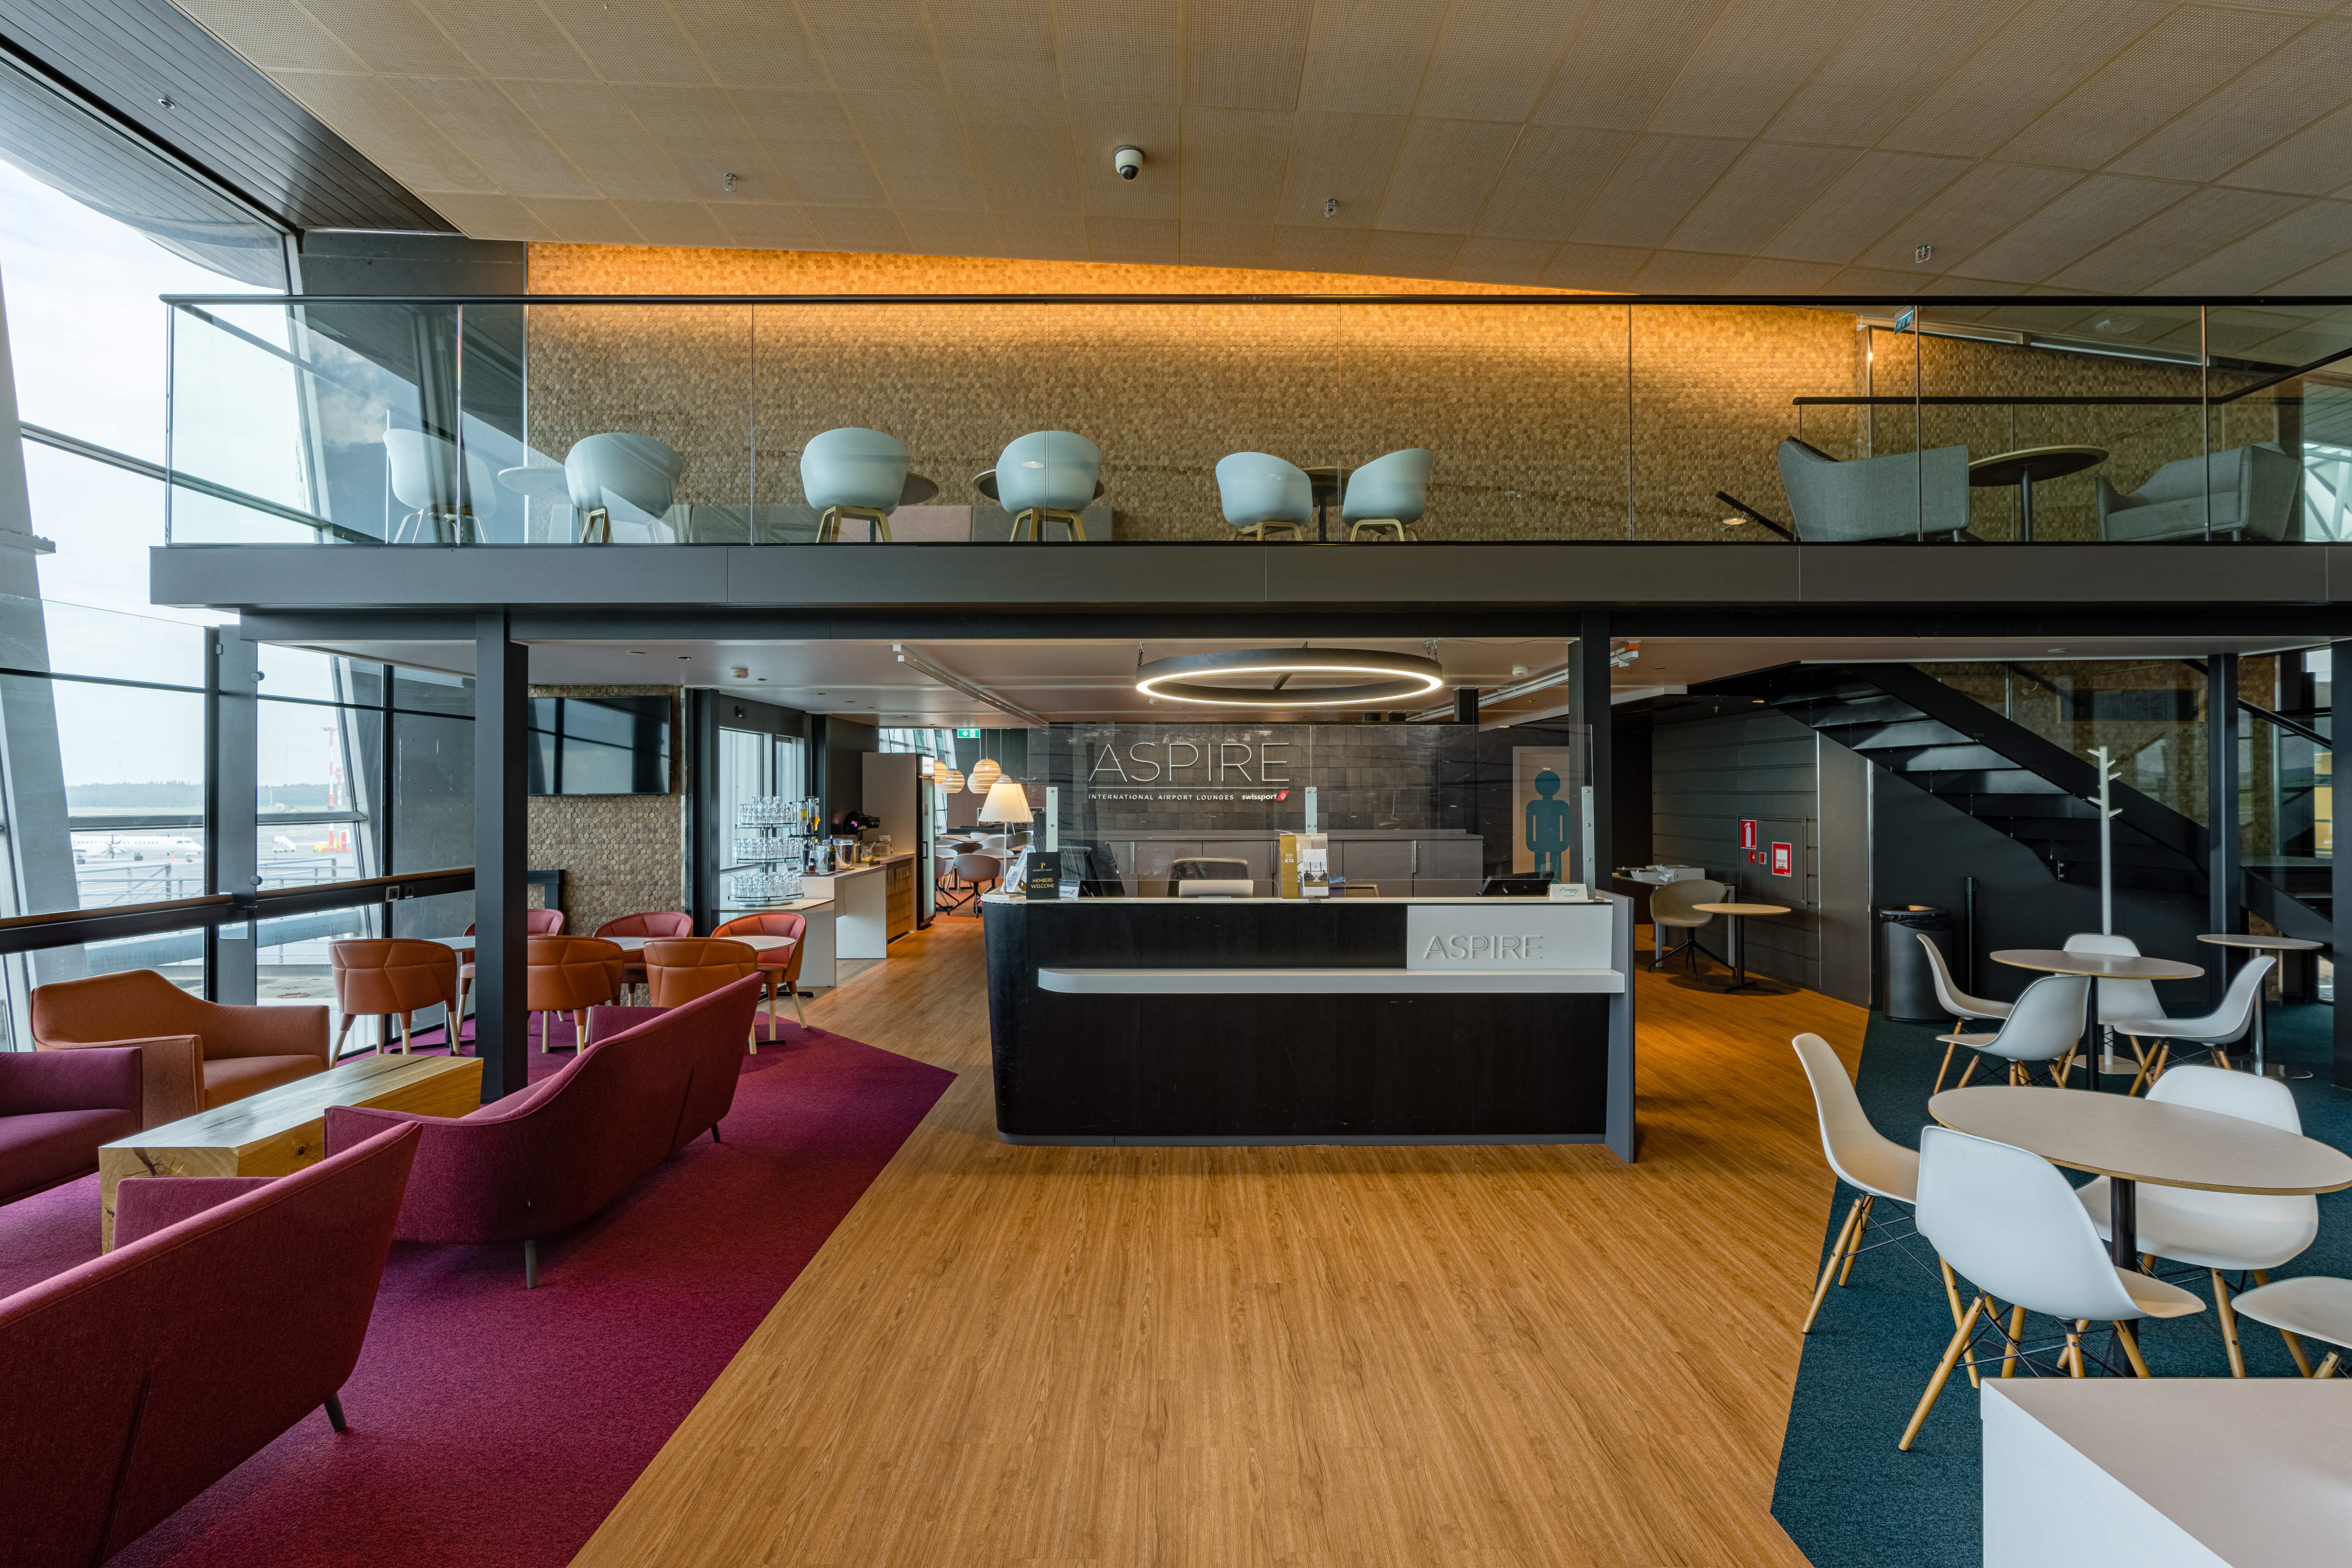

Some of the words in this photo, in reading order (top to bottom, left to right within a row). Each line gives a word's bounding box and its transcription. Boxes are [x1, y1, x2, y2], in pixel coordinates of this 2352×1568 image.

[1088, 742, 1289, 782] ASPIRE
[1241, 793, 1277, 802] swissport
[1423, 935, 1542, 959] ASPIRE
